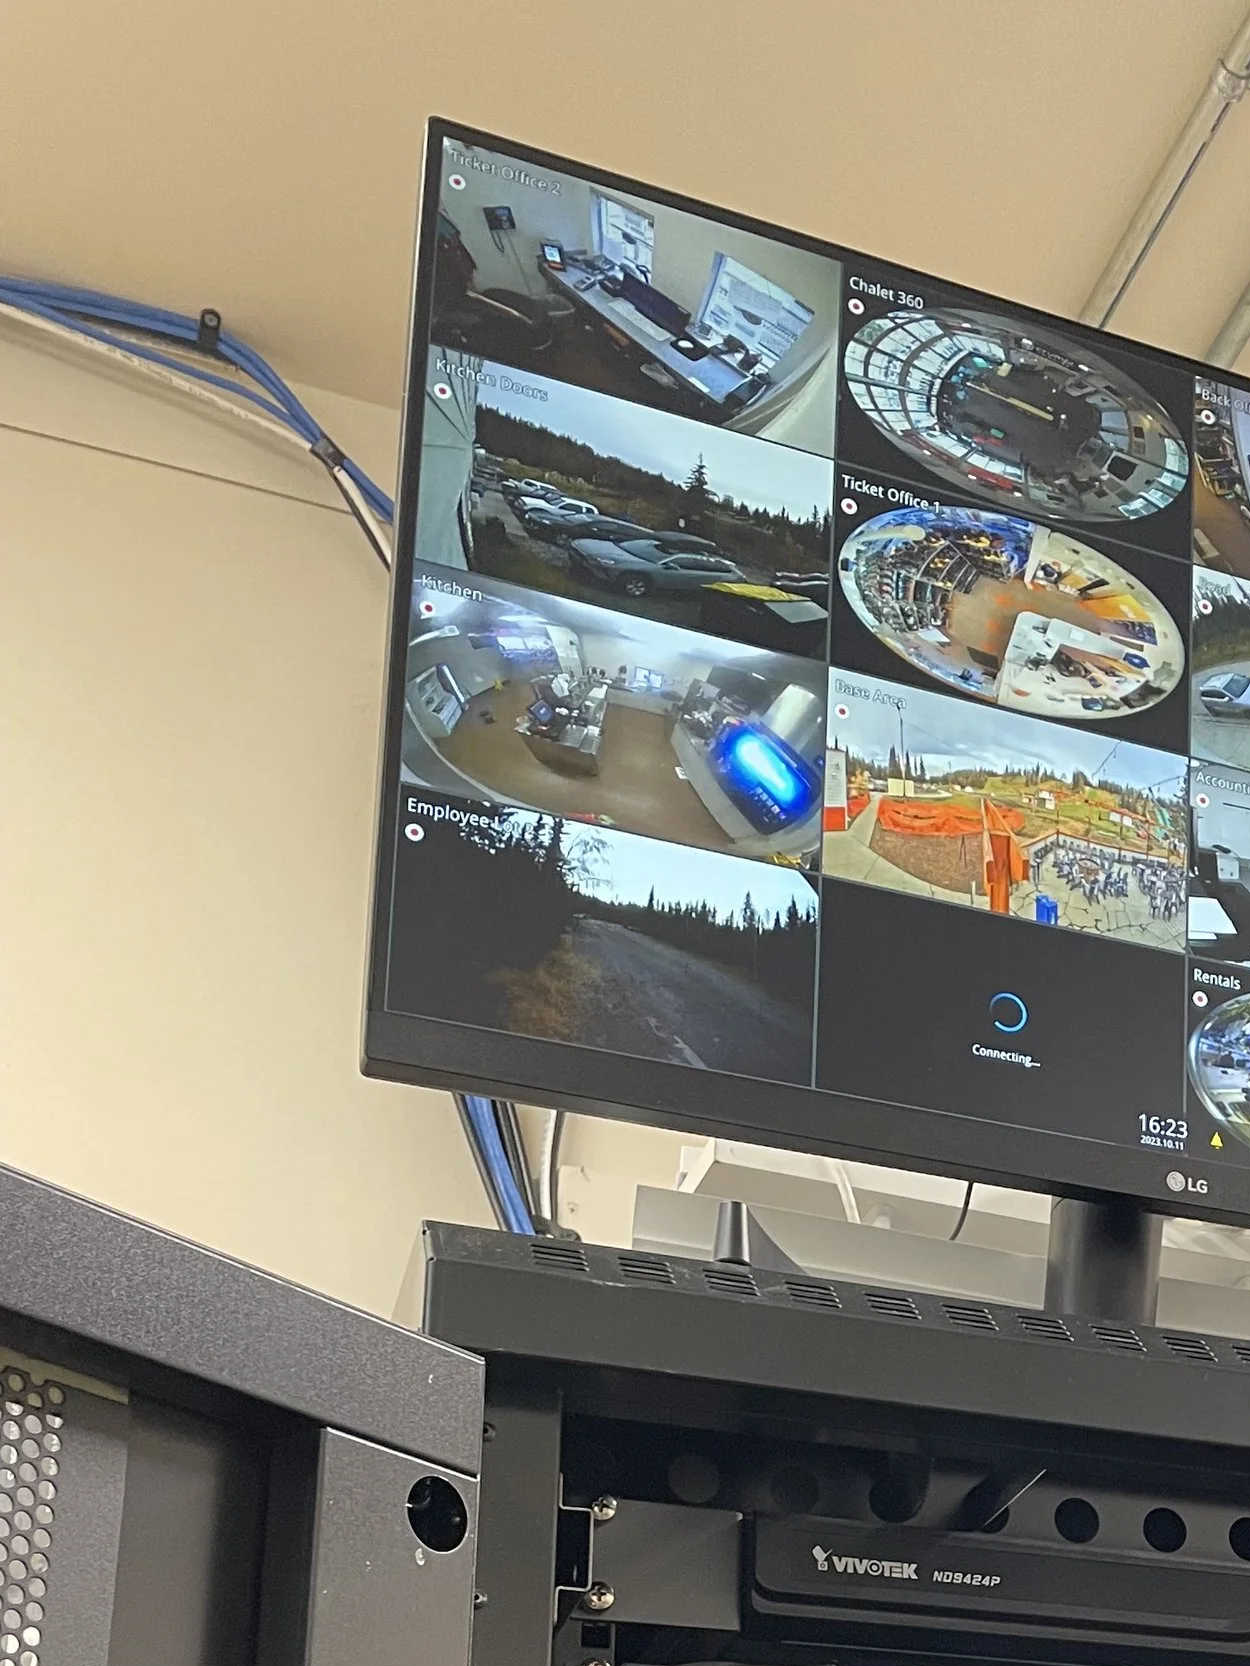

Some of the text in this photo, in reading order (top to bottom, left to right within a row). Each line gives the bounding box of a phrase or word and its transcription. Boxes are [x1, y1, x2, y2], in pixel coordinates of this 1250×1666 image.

[452, 150, 561, 196] Ticket Office 2
[849, 276, 924, 310] Chalet 360
[436, 359, 549, 402] Kitchen Doors
[1202, 388, 1231, 408] Back
[842, 474, 941, 512] Ticket Office 1
[421, 575, 484, 602] Kitchen
[835, 678, 907, 711] Base Area
[407, 797, 489, 828] Employee
[494, 816, 520, 840] Lot
[1193, 968, 1241, 991] Rentals
[972, 1043, 1041, 1068] Connecting...
[1139, 1113, 1189, 1139] 16:23
[1140, 1135, 1184, 1151] 2023.10.11
[1187, 1177, 1208, 1194] LG
[832, 1555, 1001, 1588] VIVOTEK ND9424P
